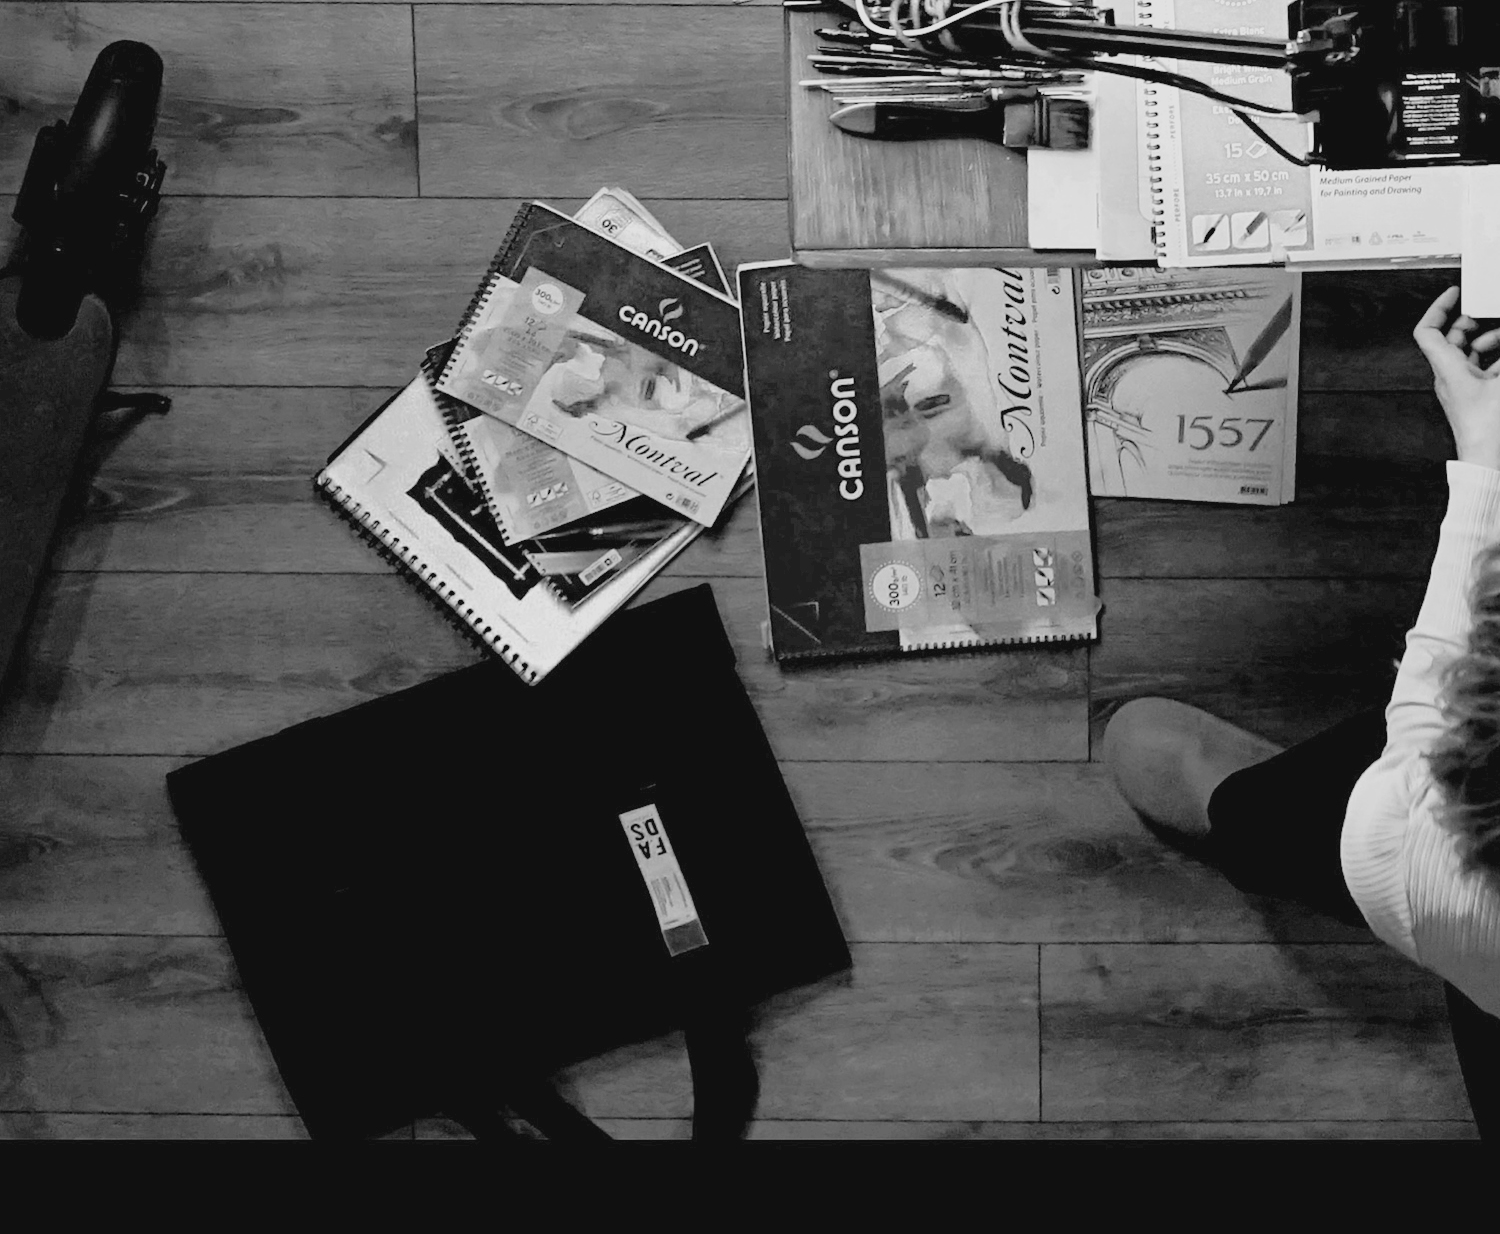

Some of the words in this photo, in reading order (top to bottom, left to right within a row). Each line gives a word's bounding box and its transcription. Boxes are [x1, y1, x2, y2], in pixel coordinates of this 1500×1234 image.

[1240, 26, 1265, 36] Blanc
[1213, 65, 1242, 76] Bright
[1211, 76, 1247, 86] Medium
[1248, 75, 1273, 84] Grain
[1224, 143, 1243, 158] 15
[1206, 173, 1221, 185] 35
[1223, 174, 1241, 183] cm
[1244, 174, 1251, 182] x
[1253, 170, 1269, 181] 50
[1272, 170, 1289, 180] cm
[1319, 176, 1353, 185] Medium
[1355, 175, 1387, 184] Grained
[1388, 174, 1412, 183] Paper
[1234, 187, 1243, 196] in
[1274, 186, 1283, 195] in
[1320, 188, 1332, 197] for
[1334, 188, 1368, 197] Painting
[1369, 187, 1386, 195] and
[1387, 186, 1422, 195] Drawing
[534, 287, 552, 301] 300
[524, 316, 535, 326] 12
[619, 304, 699, 357] CANSON
[998, 267, 1036, 459] Montval
[830, 377, 863, 500] CANSON
[1174, 412, 1274, 455] 1557
[589, 419, 718, 488] Montval
[888, 583, 899, 606] 300
[933, 582, 945, 596] 12
